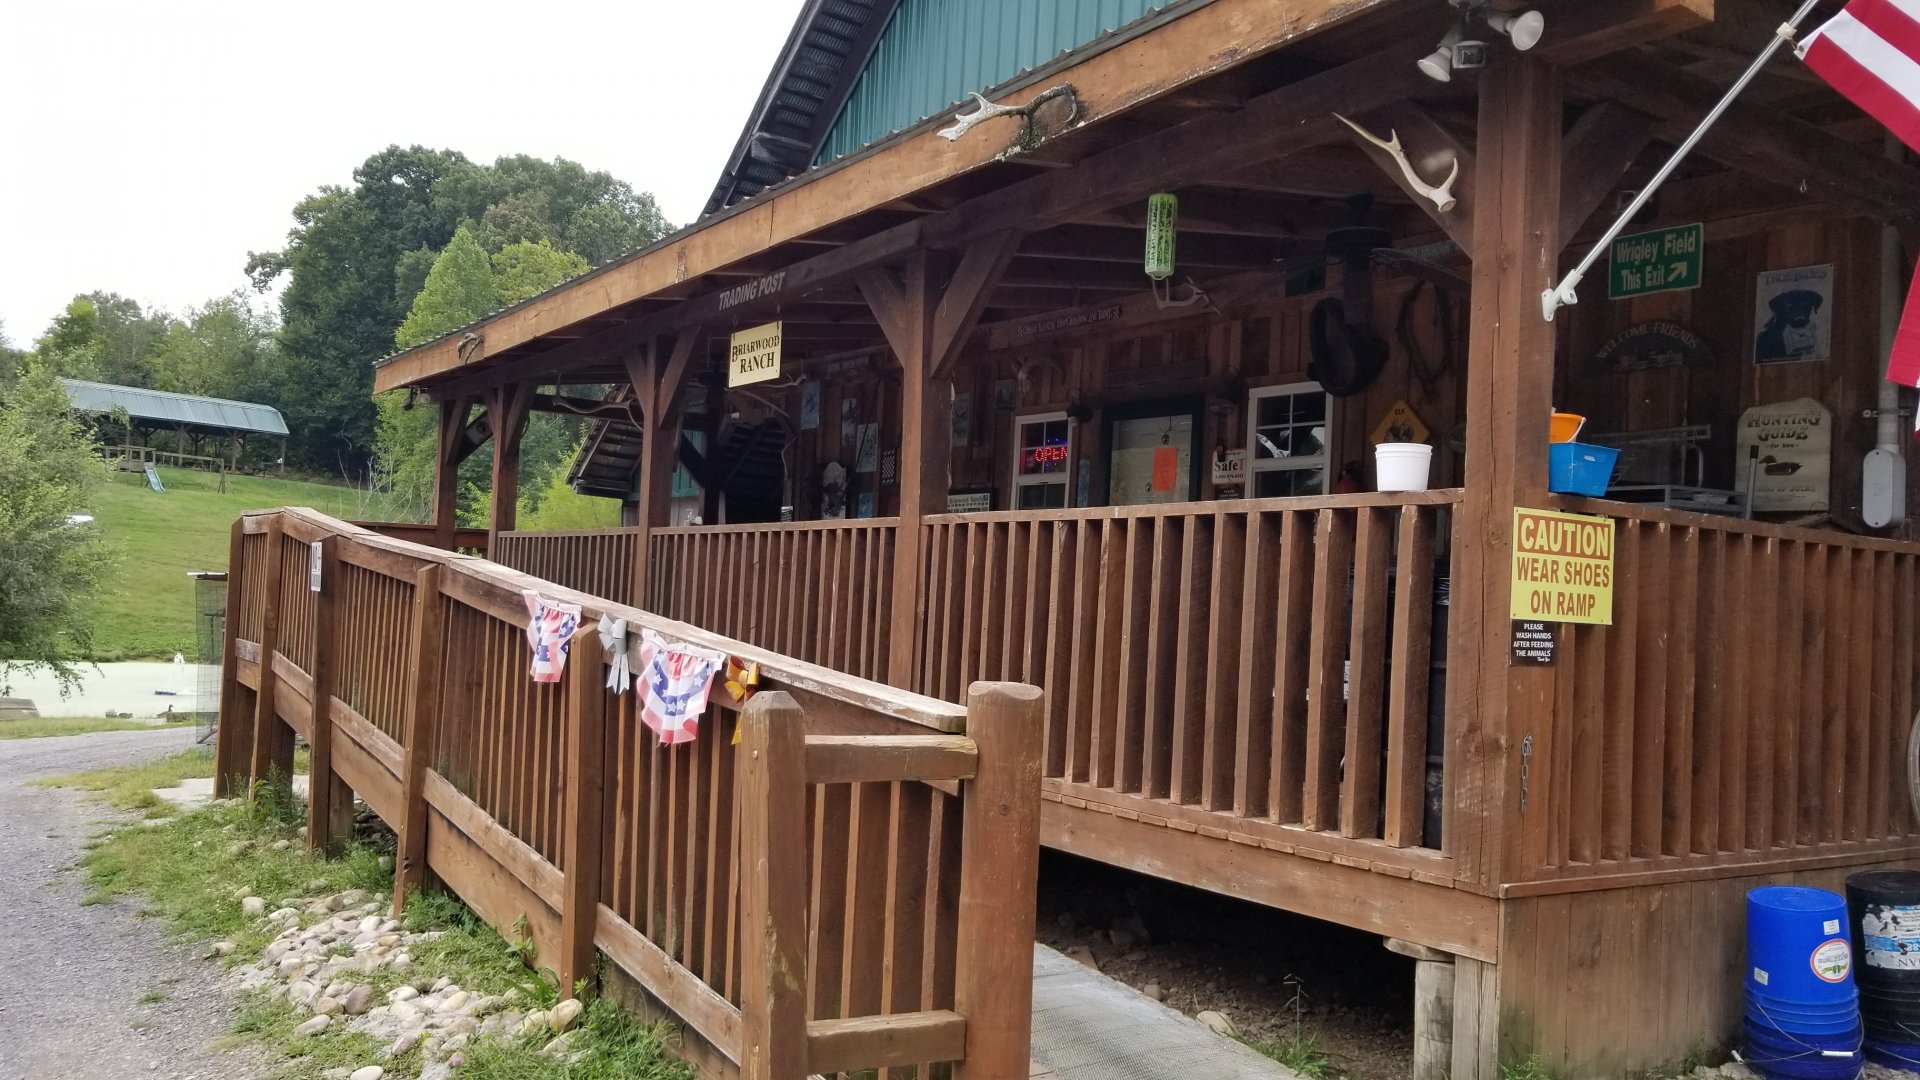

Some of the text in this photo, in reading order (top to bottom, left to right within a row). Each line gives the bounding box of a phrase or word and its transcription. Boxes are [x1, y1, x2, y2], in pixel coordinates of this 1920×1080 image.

[1617, 230, 1696, 266] Wrigley Field
[1621, 264, 1665, 291] This Exit
[718, 271, 786, 311] TRADING POST
[731, 335, 780, 363] BRIARWOOD
[1596, 323, 1649, 359] WELCOME
[739, 351, 775, 374] RANCH
[1746, 409, 1821, 428] HUNTING
[1757, 425, 1809, 442] GUIDE
[1035, 446, 1068, 462] OPEN
[1520, 517, 1609, 556] CAUTION
[1517, 556, 1610, 588] WEAR SHOES
[1530, 589, 1596, 617] ON RAMP
[1515, 631, 1552, 640] WASH HANDS
[1523, 623, 1544, 631] PLEASE
[1513, 640, 1554, 649] AFTER FEEDING
[1515, 649, 1551, 657] THE ANIMALS
